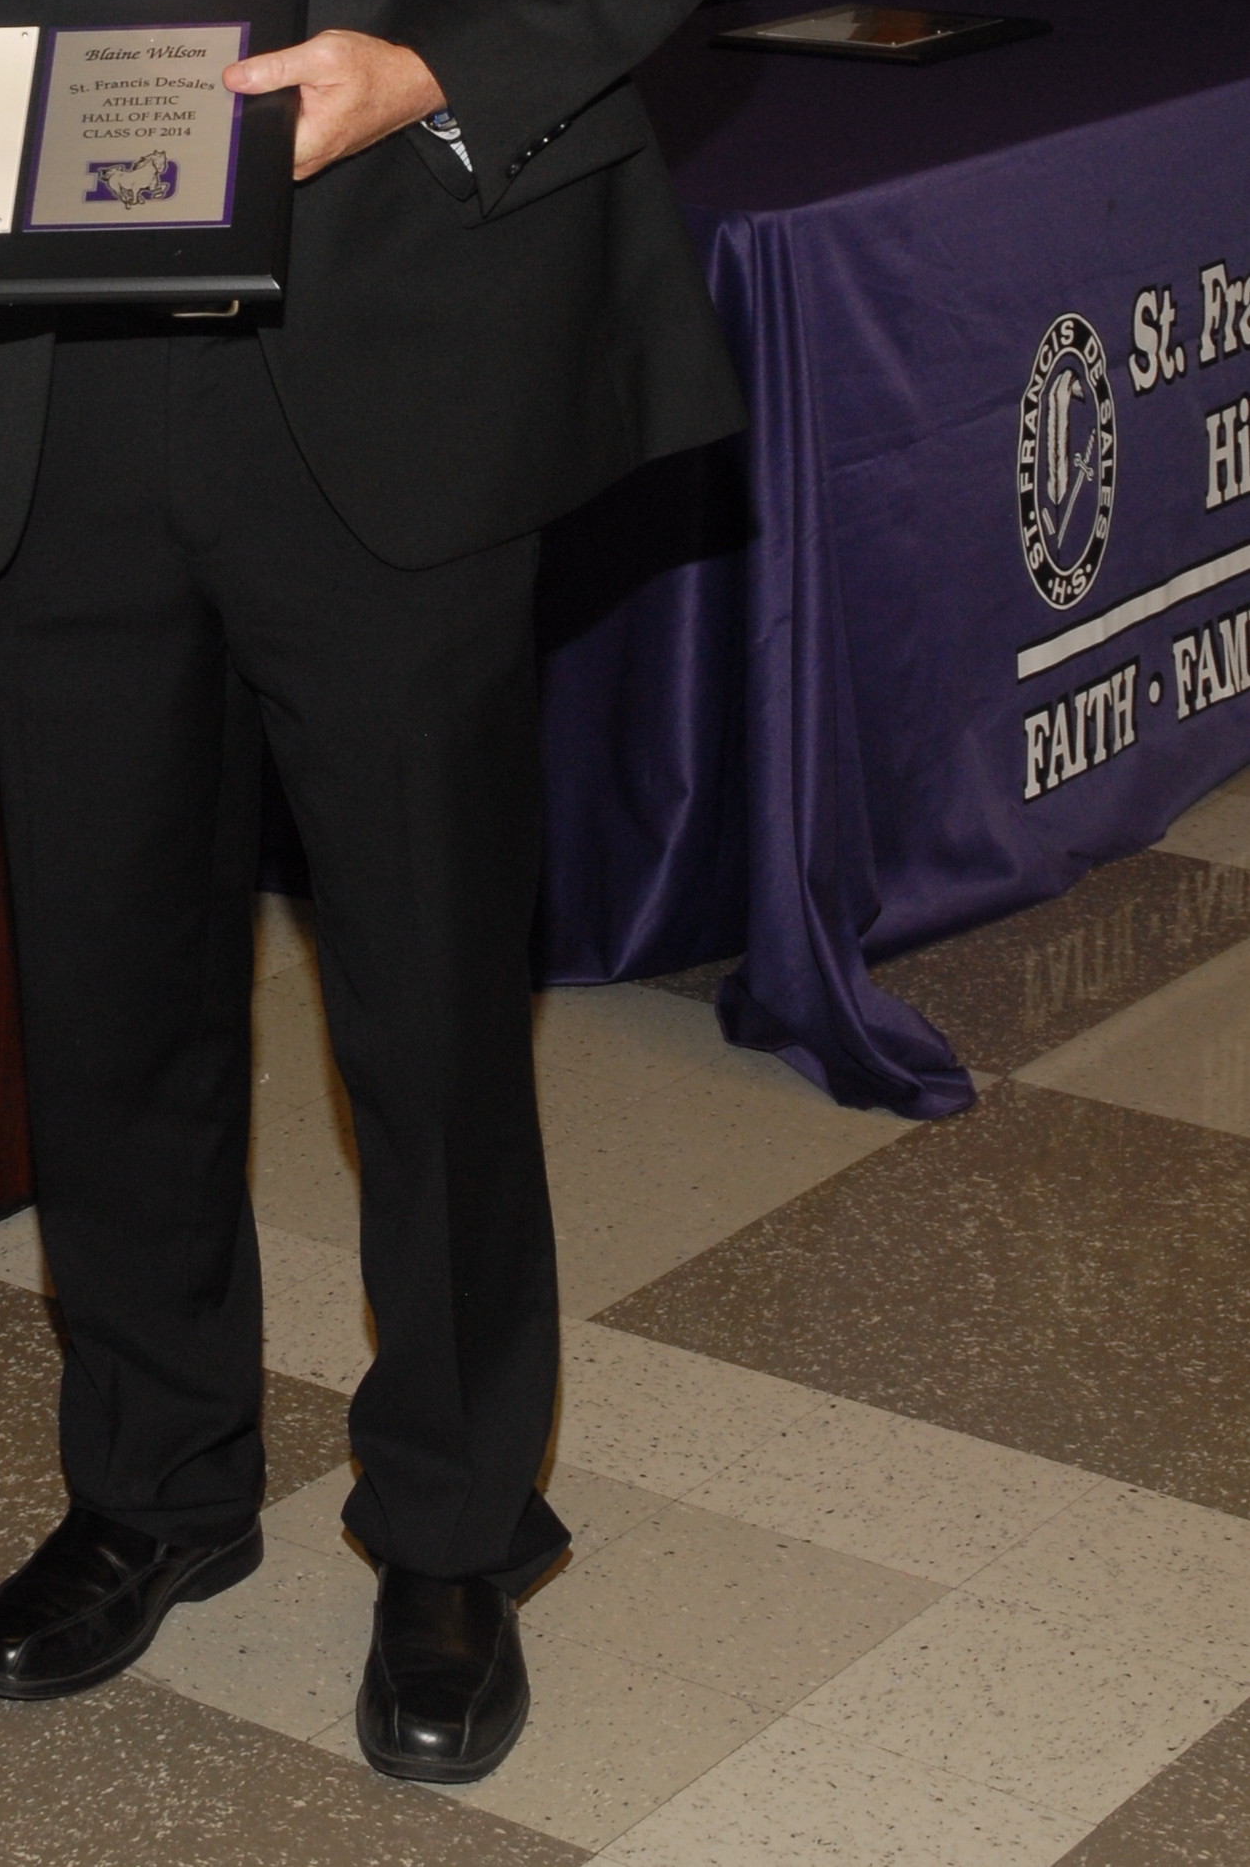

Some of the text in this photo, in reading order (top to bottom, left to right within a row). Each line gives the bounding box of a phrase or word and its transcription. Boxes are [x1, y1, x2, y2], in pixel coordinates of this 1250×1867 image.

[85, 45, 207, 61] Blaine Wilson
[69, 77, 216, 94] St. Francis DeSales
[102, 95, 178, 107] ATHLETIC
[81, 111, 196, 123] HALL OF FAME
[83, 127, 191, 139] CLASS OF 2014
[1084, 335, 1103, 387] DE
[1129, 290, 1185, 392] St.
[1020, 320, 1075, 493] FRANCIS
[1095, 398, 1113, 540] SALES
[1023, 511, 1044, 570] ST.
[1025, 664, 1137, 800] FAITH
